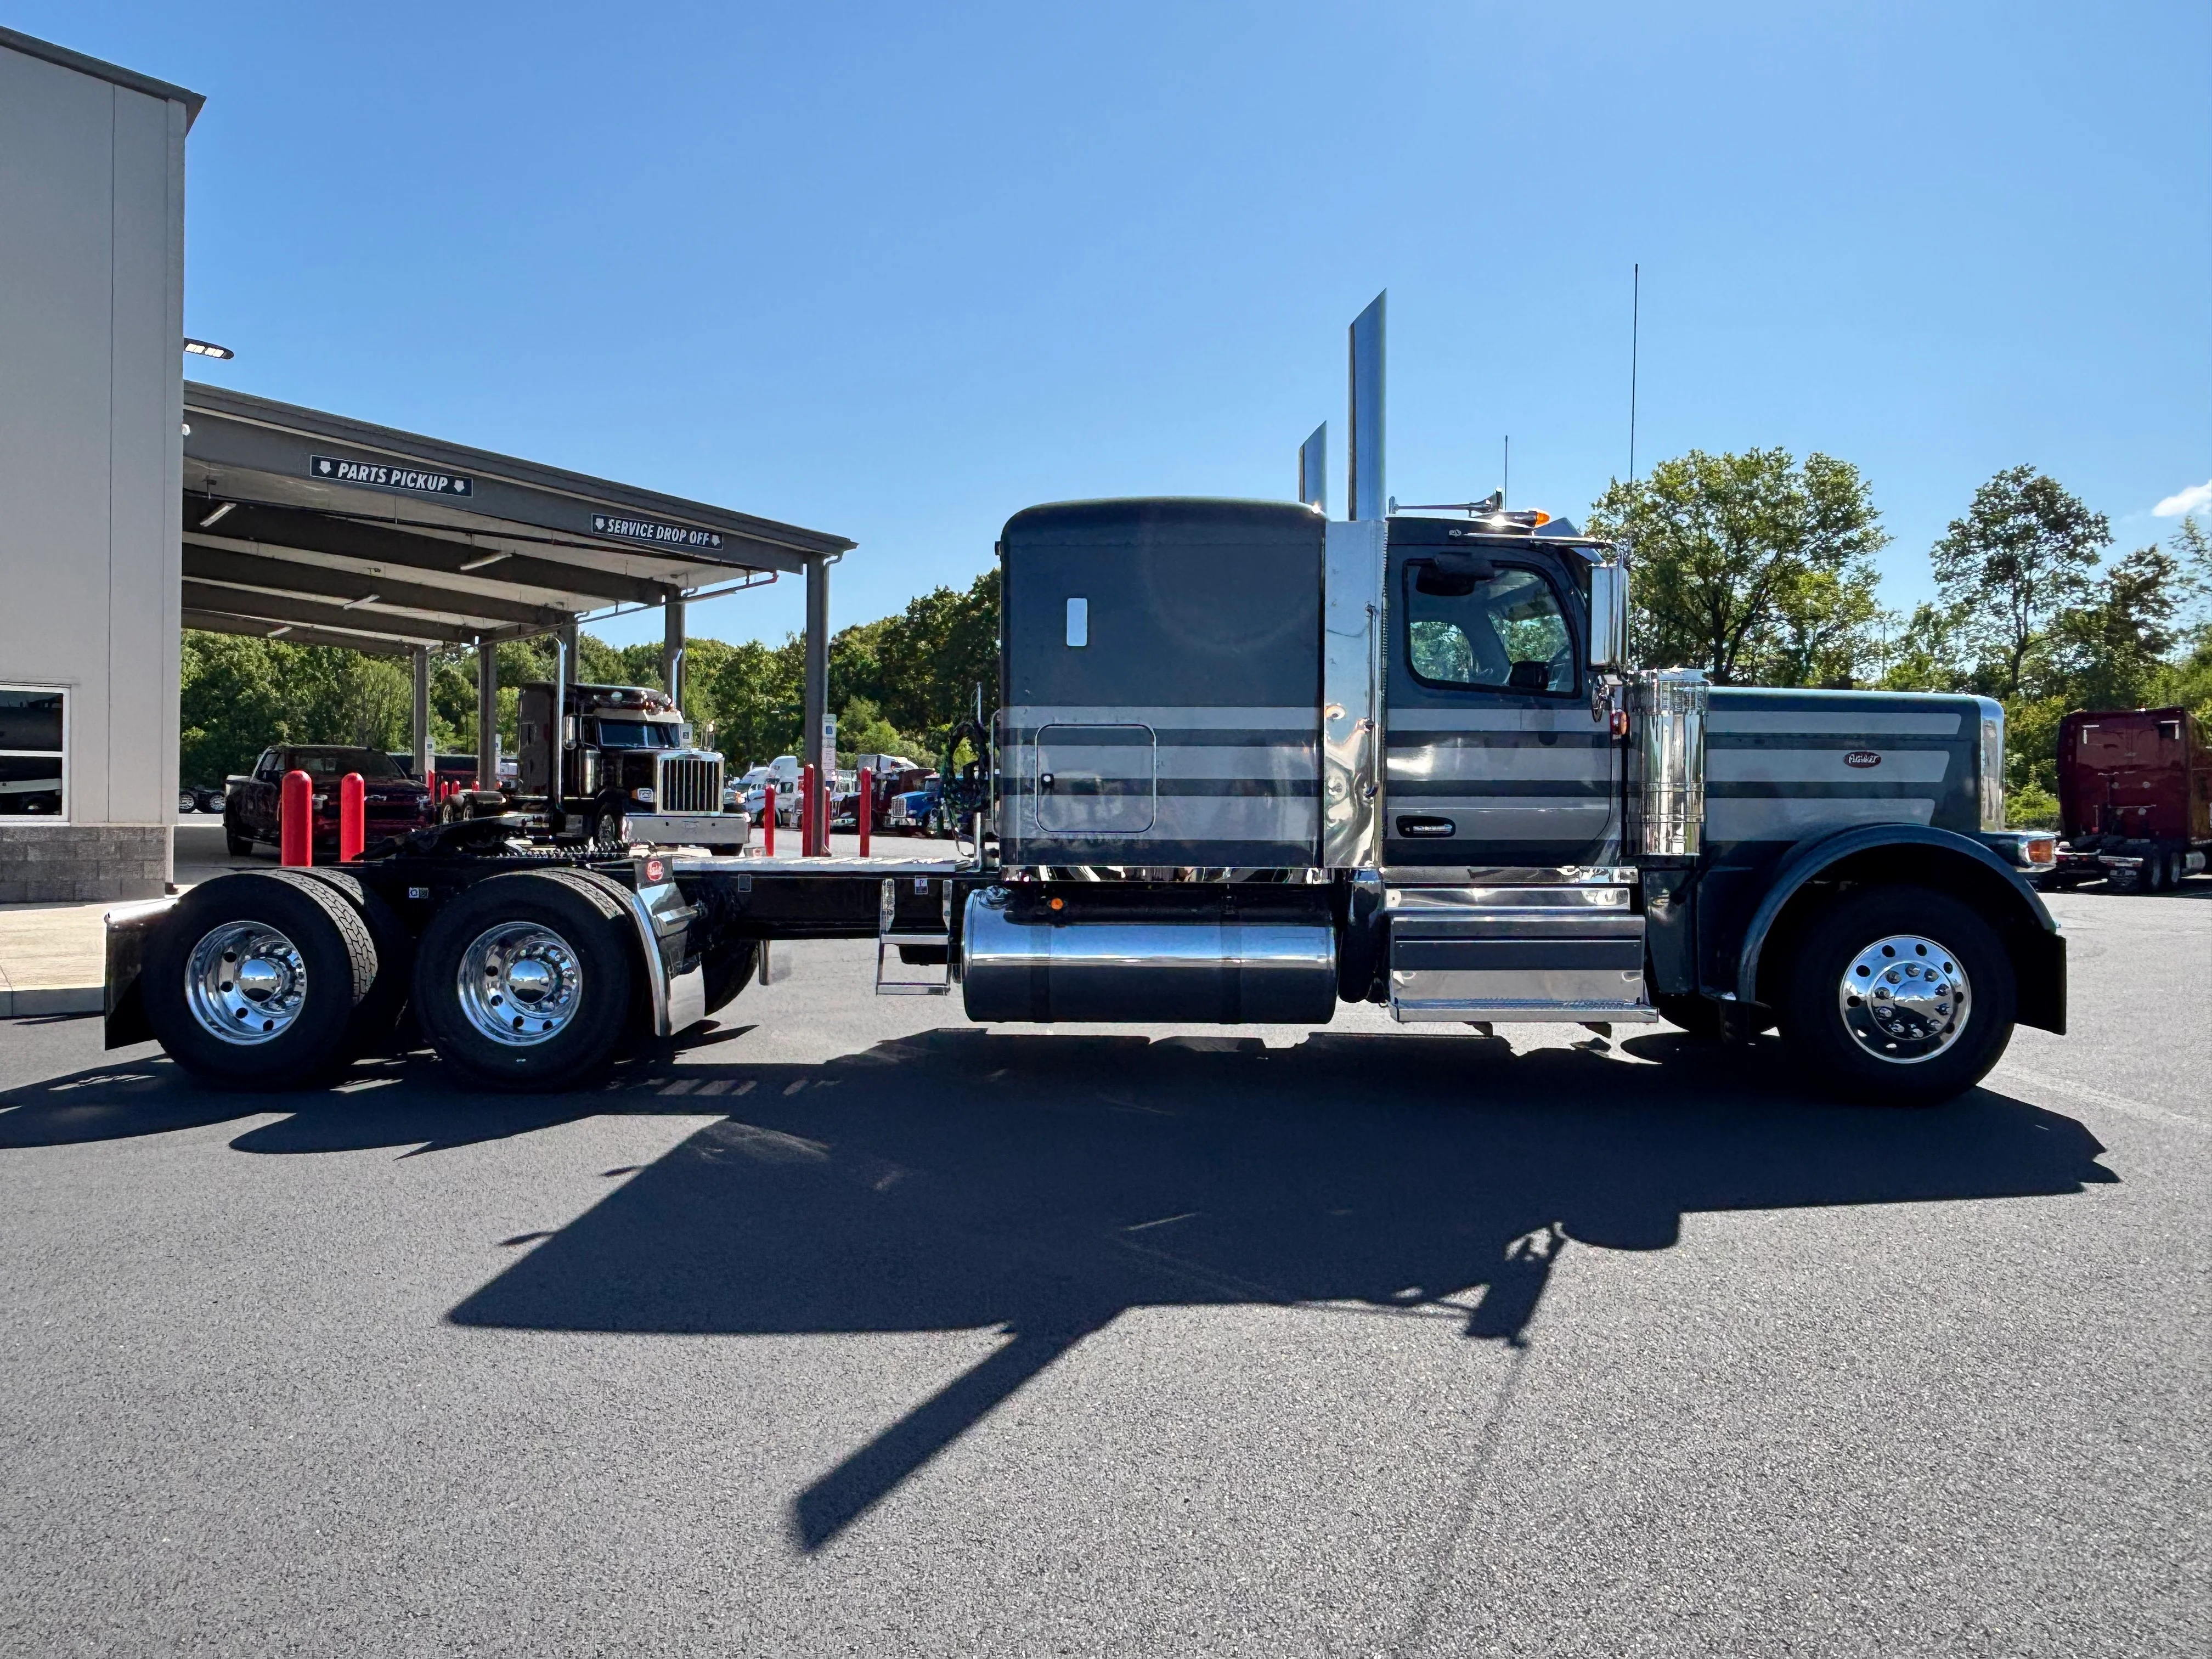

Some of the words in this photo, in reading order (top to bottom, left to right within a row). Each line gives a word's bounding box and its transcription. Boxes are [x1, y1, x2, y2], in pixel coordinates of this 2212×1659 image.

[337, 462, 387, 483] PARTS
[390, 470, 448, 491] PICKUP
[607, 518, 654, 538] SERVICE
[656, 526, 687, 542] DROP
[689, 531, 709, 546] OFF
